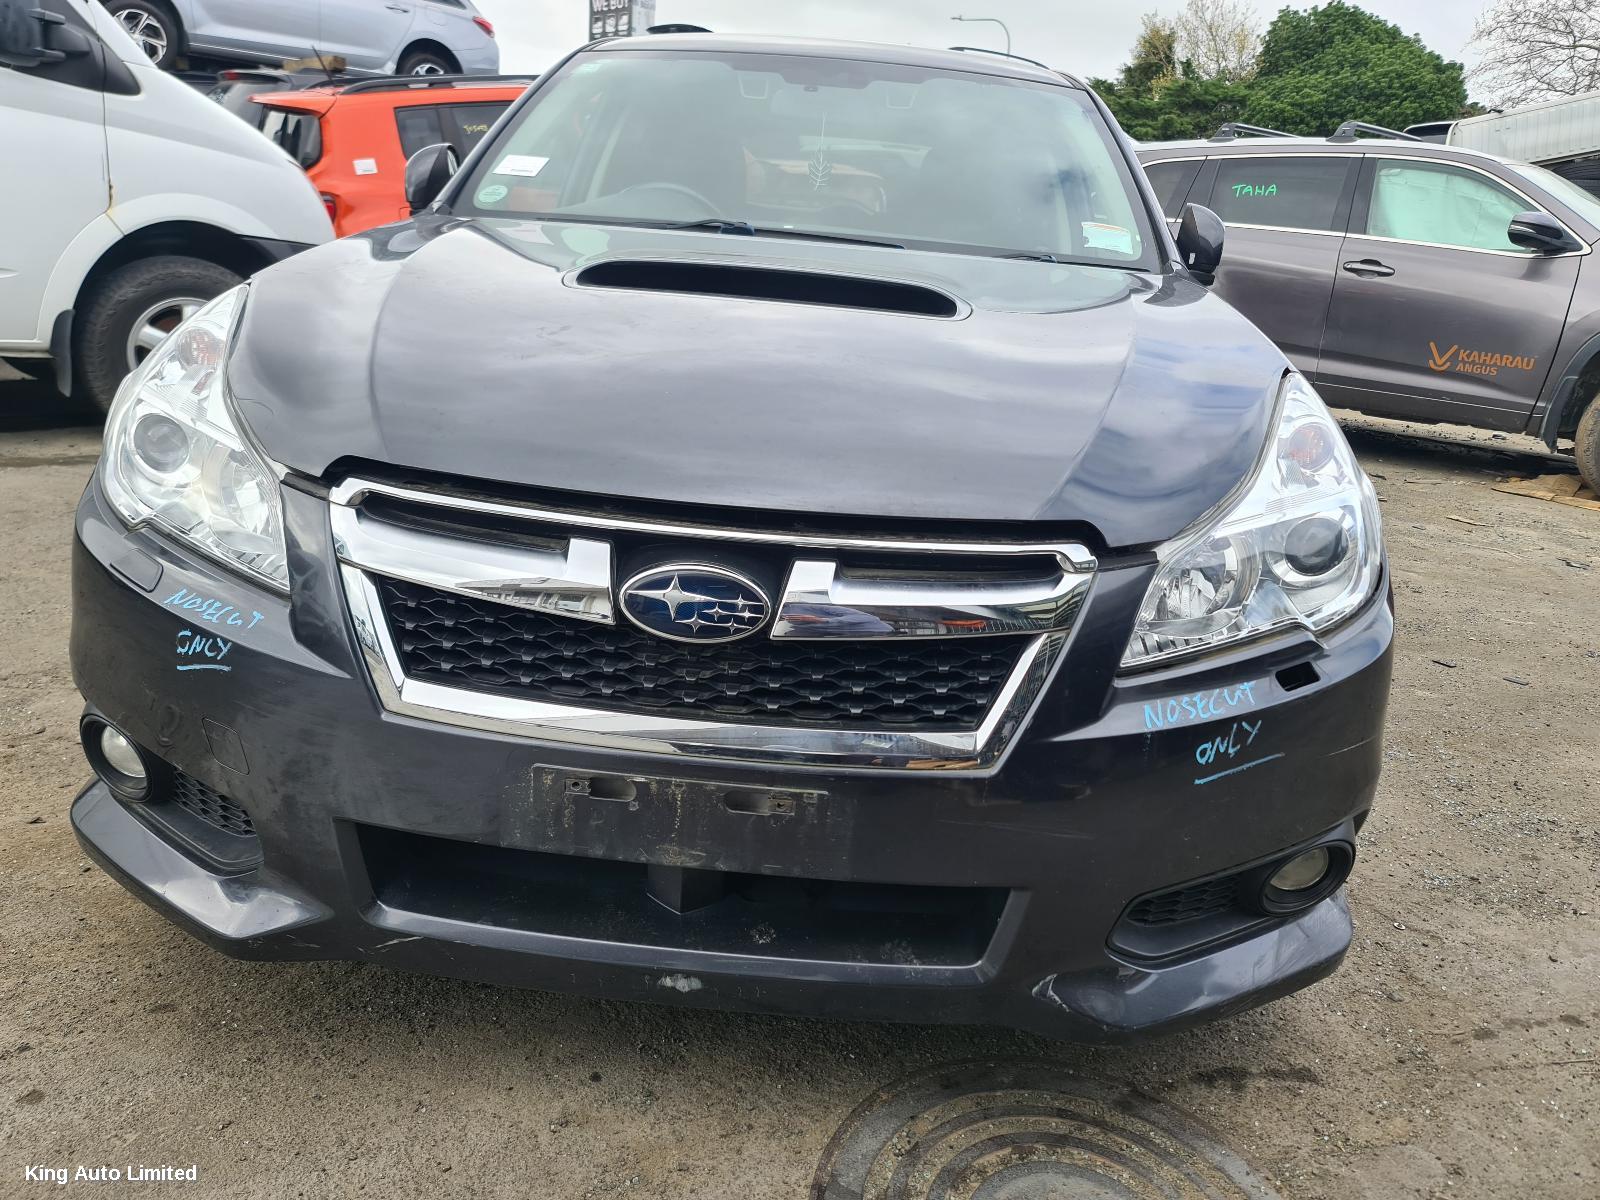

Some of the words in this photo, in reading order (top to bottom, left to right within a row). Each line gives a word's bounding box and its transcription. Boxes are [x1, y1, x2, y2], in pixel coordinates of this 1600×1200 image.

[592, 0, 608, 12] WE
[610, 0, 629, 10] BUY
[1458, 349, 1536, 370] KAHARAU
[1456, 363, 1498, 376] ANGUS
[1195, 719, 1263, 766] ONLY
